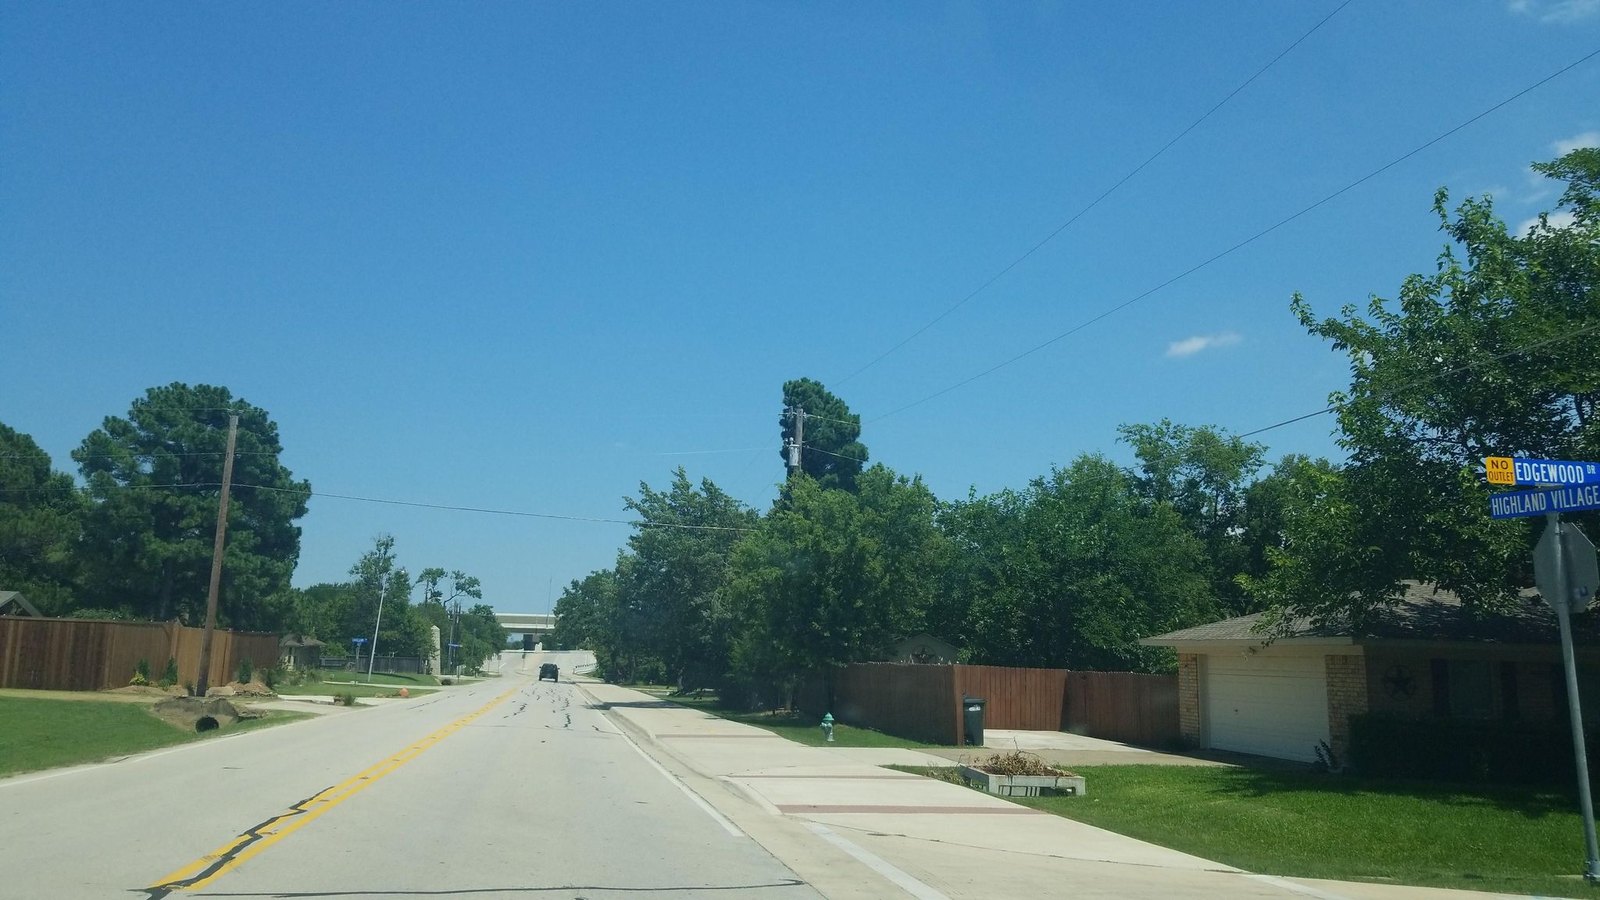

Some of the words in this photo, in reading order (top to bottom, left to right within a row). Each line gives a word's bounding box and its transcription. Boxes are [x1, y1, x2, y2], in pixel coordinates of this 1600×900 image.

[1491, 460, 1509, 470] NO
[1515, 462, 1585, 483] EDGEWOOD
[1586, 464, 1596, 474] DR
[1488, 471, 1514, 482] OUTLET
[1491, 492, 1547, 516] HIGHLAND
[1550, 485, 1600, 509] VILLAGE
